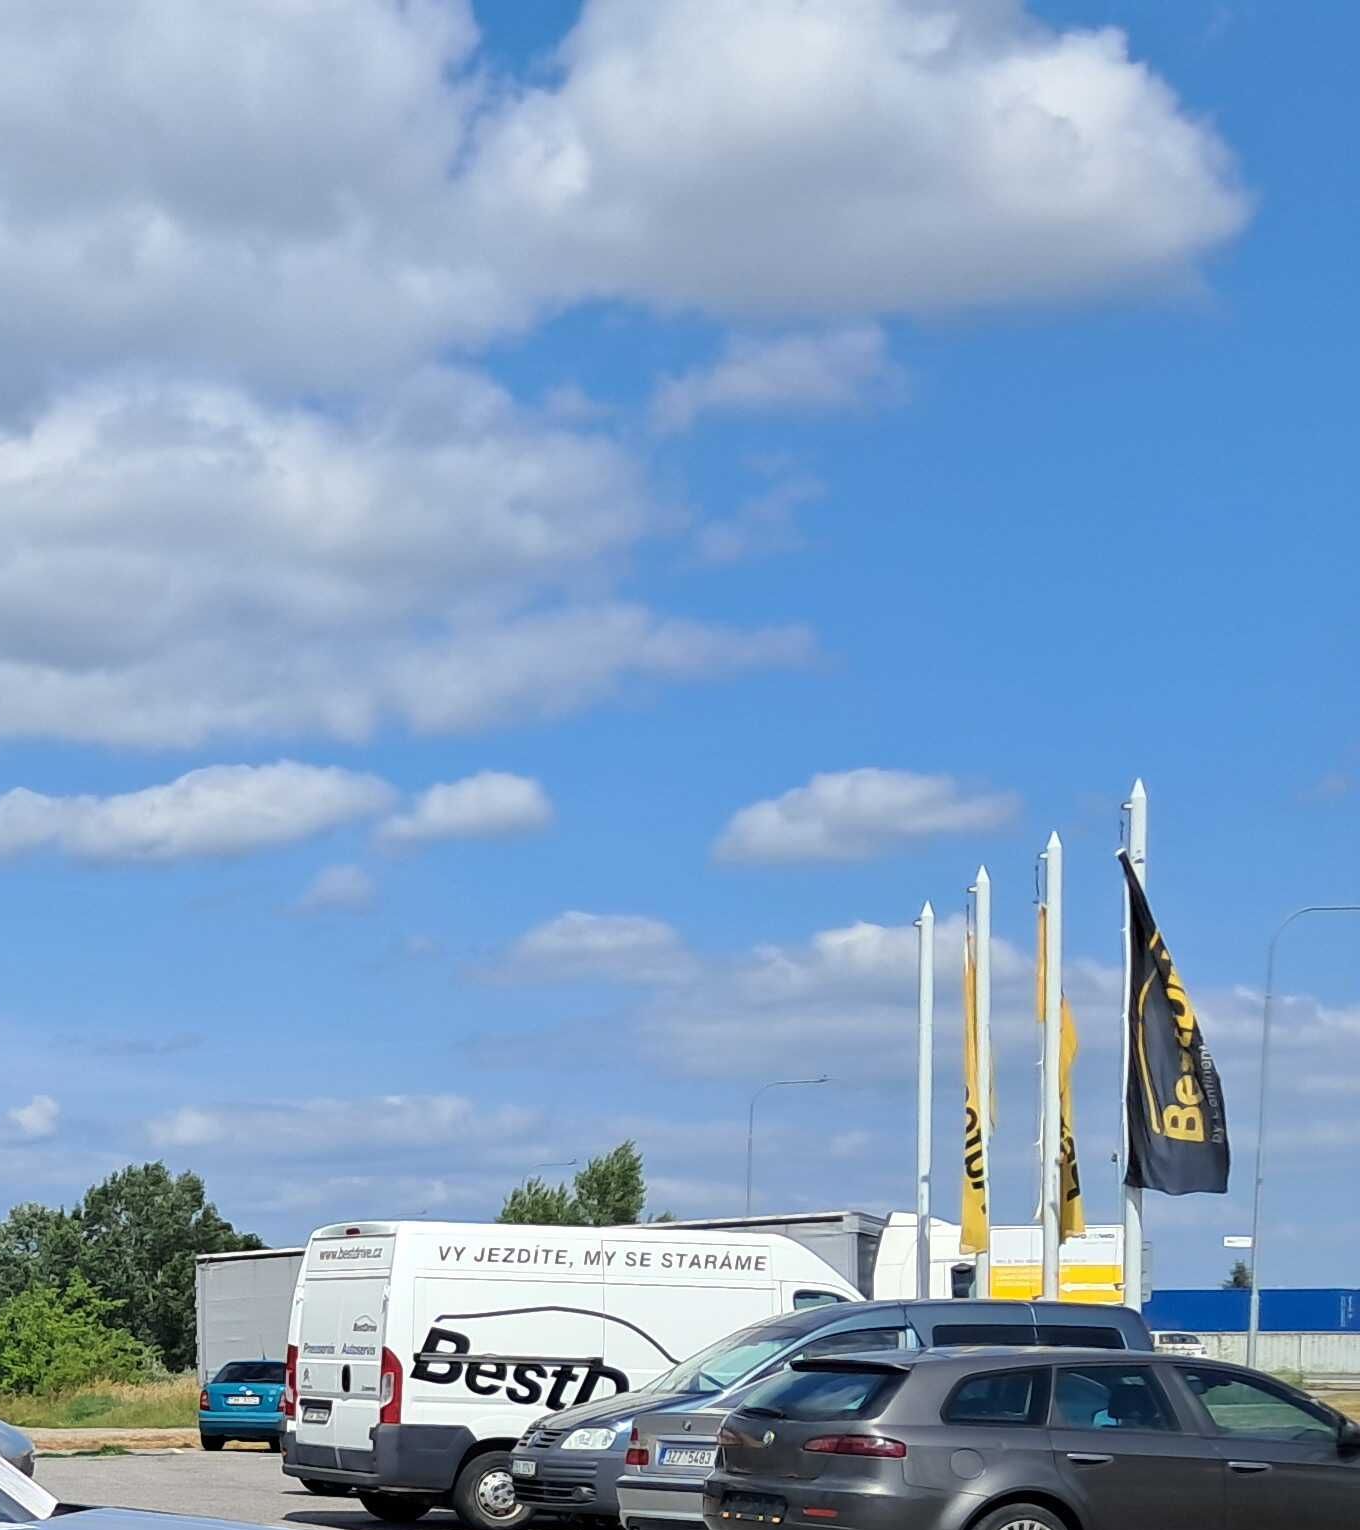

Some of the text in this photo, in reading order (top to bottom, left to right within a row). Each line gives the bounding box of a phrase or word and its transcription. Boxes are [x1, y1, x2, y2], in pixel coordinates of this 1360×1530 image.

[438, 1244, 768, 1272] VY JEZDÍTE, MY SE STARÁME
